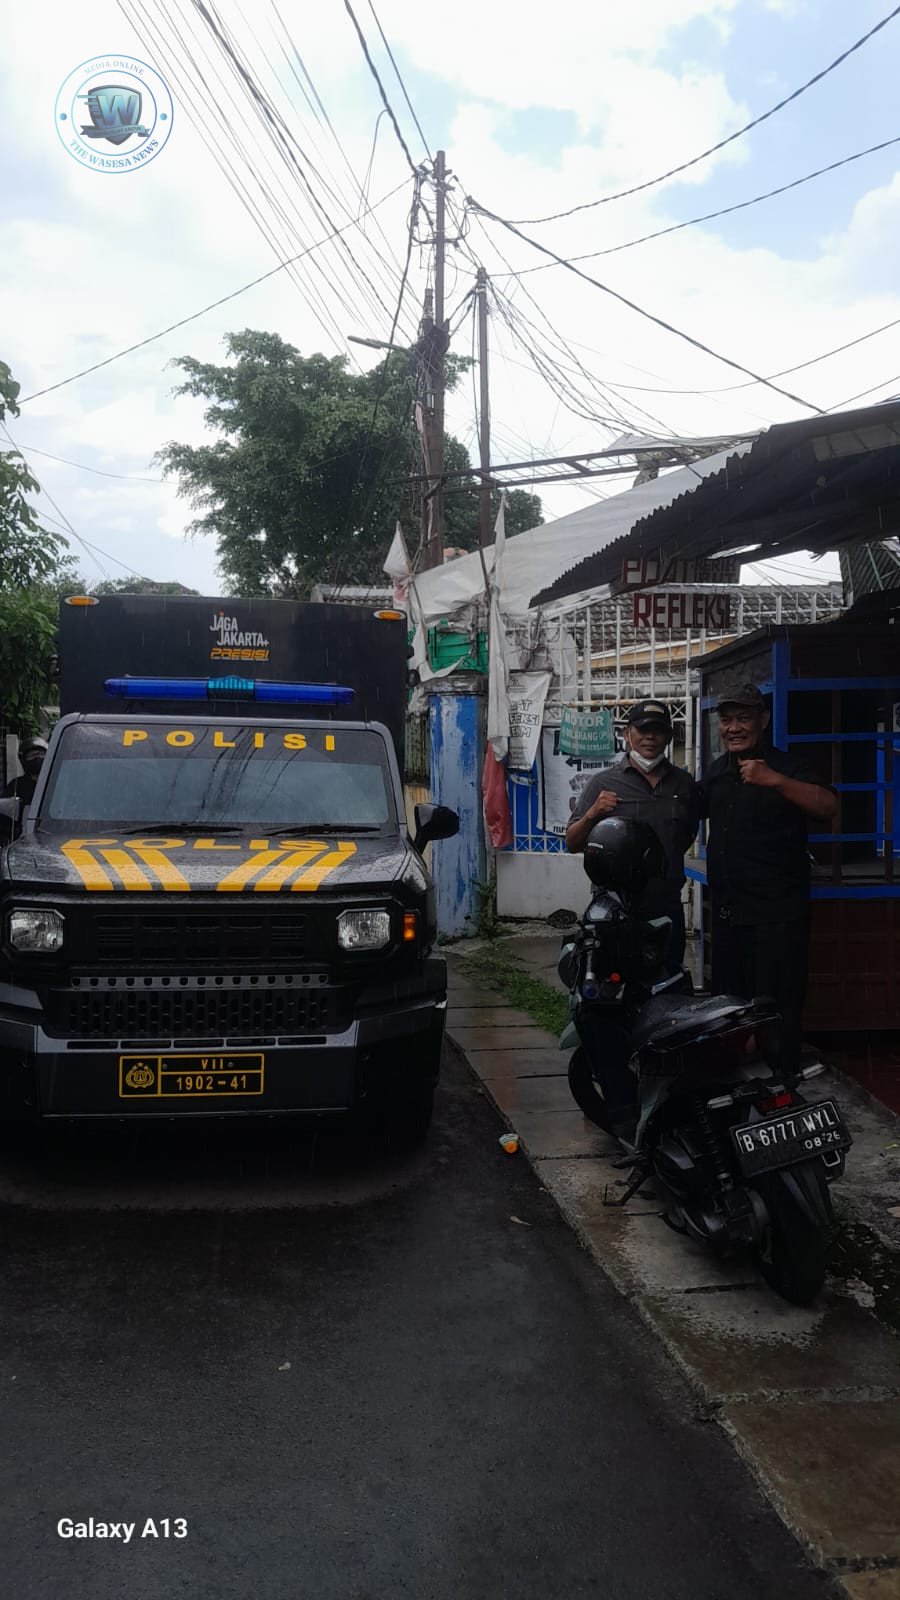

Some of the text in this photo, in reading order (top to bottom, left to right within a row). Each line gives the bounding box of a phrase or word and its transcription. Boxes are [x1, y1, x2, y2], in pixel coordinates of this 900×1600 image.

[633, 593, 730, 629] REFLEKSI
[209, 613, 238, 631] JAGA
[210, 648, 270, 659] PRESISI
[564, 710, 604, 727] MOTOR
[122, 729, 336, 751] POLISI
[60, 838, 357, 852] POLISI
[201, 1058, 224, 1070] VII
[742, 1108, 835, 1152] B 6777 WYL
